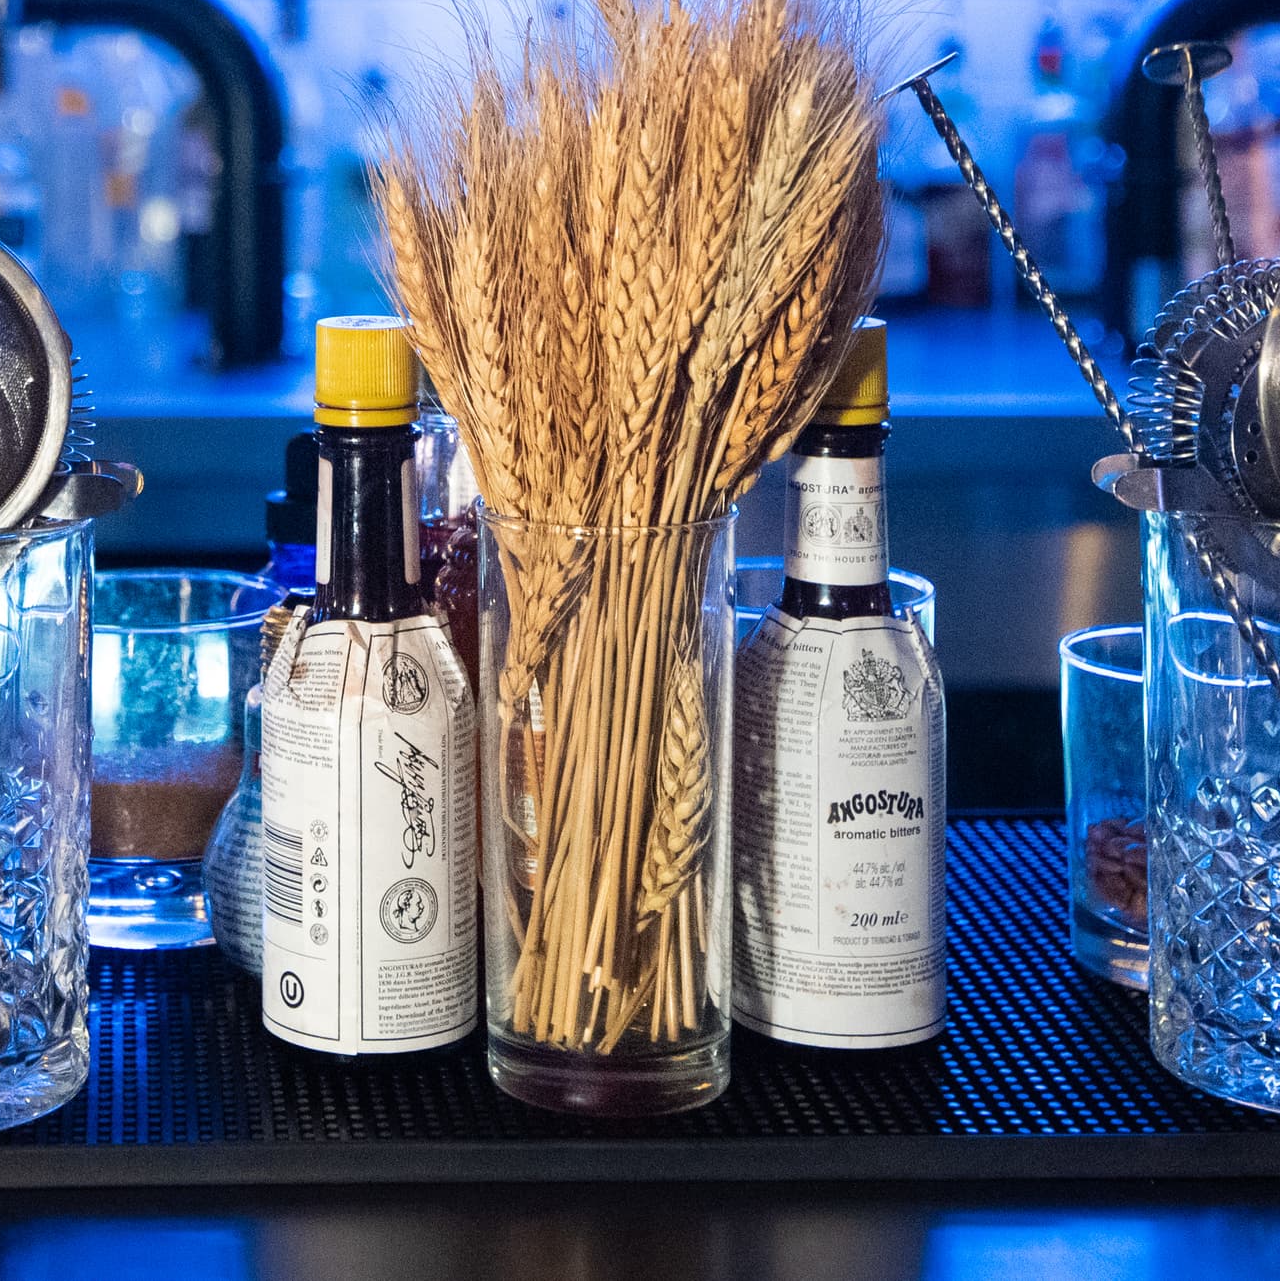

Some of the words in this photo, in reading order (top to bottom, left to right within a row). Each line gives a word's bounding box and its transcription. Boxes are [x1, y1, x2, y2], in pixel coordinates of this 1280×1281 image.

[835, 555, 867, 564] HOUSE
[793, 642, 823, 654] bitters
[827, 790, 924, 824] ANGOSTURA
[834, 828, 887, 840] aromatic
[890, 825, 921, 839] bitters
[850, 913, 878, 927] 200
[378, 1013, 393, 1021] Free
[395, 1010, 426, 1021] Download
